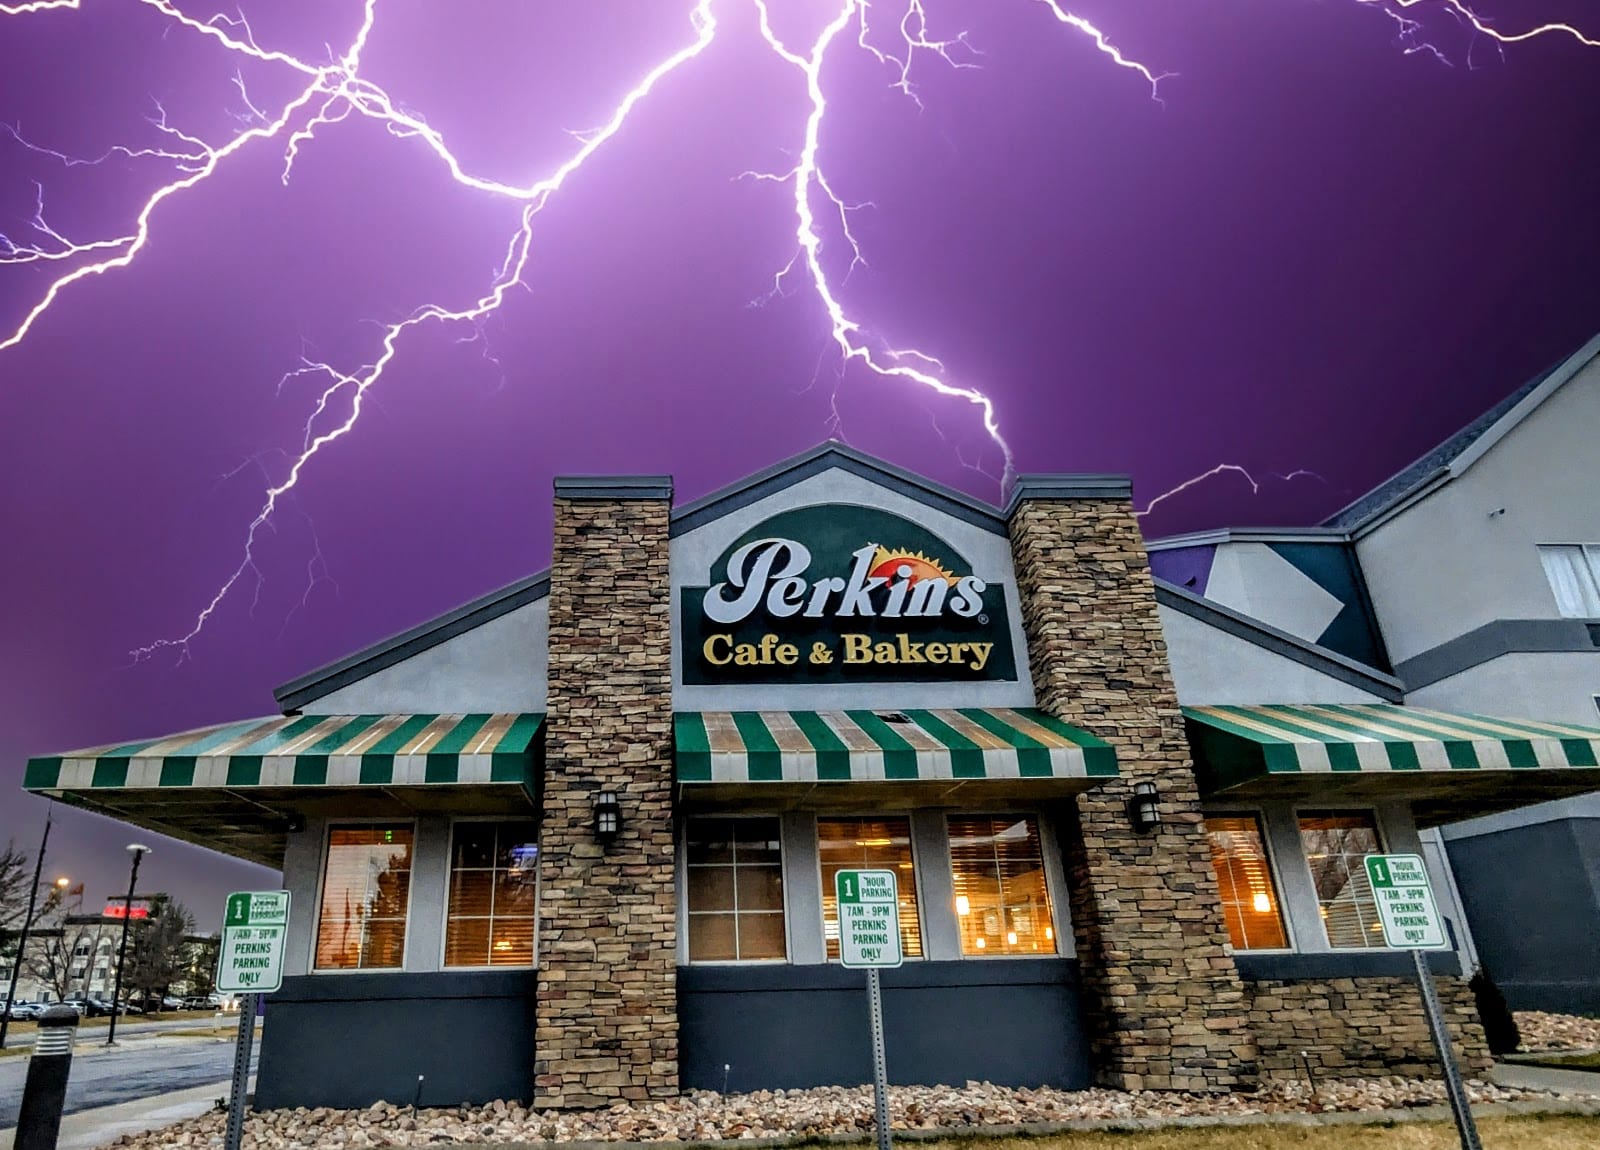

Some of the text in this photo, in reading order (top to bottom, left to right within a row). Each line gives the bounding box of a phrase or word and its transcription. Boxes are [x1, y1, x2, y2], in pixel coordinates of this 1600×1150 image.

[703, 537, 986, 623] Perkins
[703, 634, 993, 671] Cafe & Bakery
[1374, 864, 1385, 881] 1
[1392, 872, 1424, 881] PARKING
[845, 879, 853, 896] 1
[866, 877, 886, 887] HOUR
[861, 888, 892, 898] PARKING
[1381, 890, 1400, 900] 7AM
[847, 906, 864, 917] 7AM
[872, 906, 890, 916] 9PM
[1390, 903, 1425, 913] PERKINS
[852, 920, 887, 931] PERKINS
[1393, 916, 1429, 927] PARKING
[853, 934, 888, 945] PARKING
[1404, 930, 1425, 940] ONLY
[234, 943, 272, 954] PERKINS
[861, 948, 882, 959] ONLY
[233, 957, 270, 969] PARKING
[239, 972, 261, 983] ONLY
